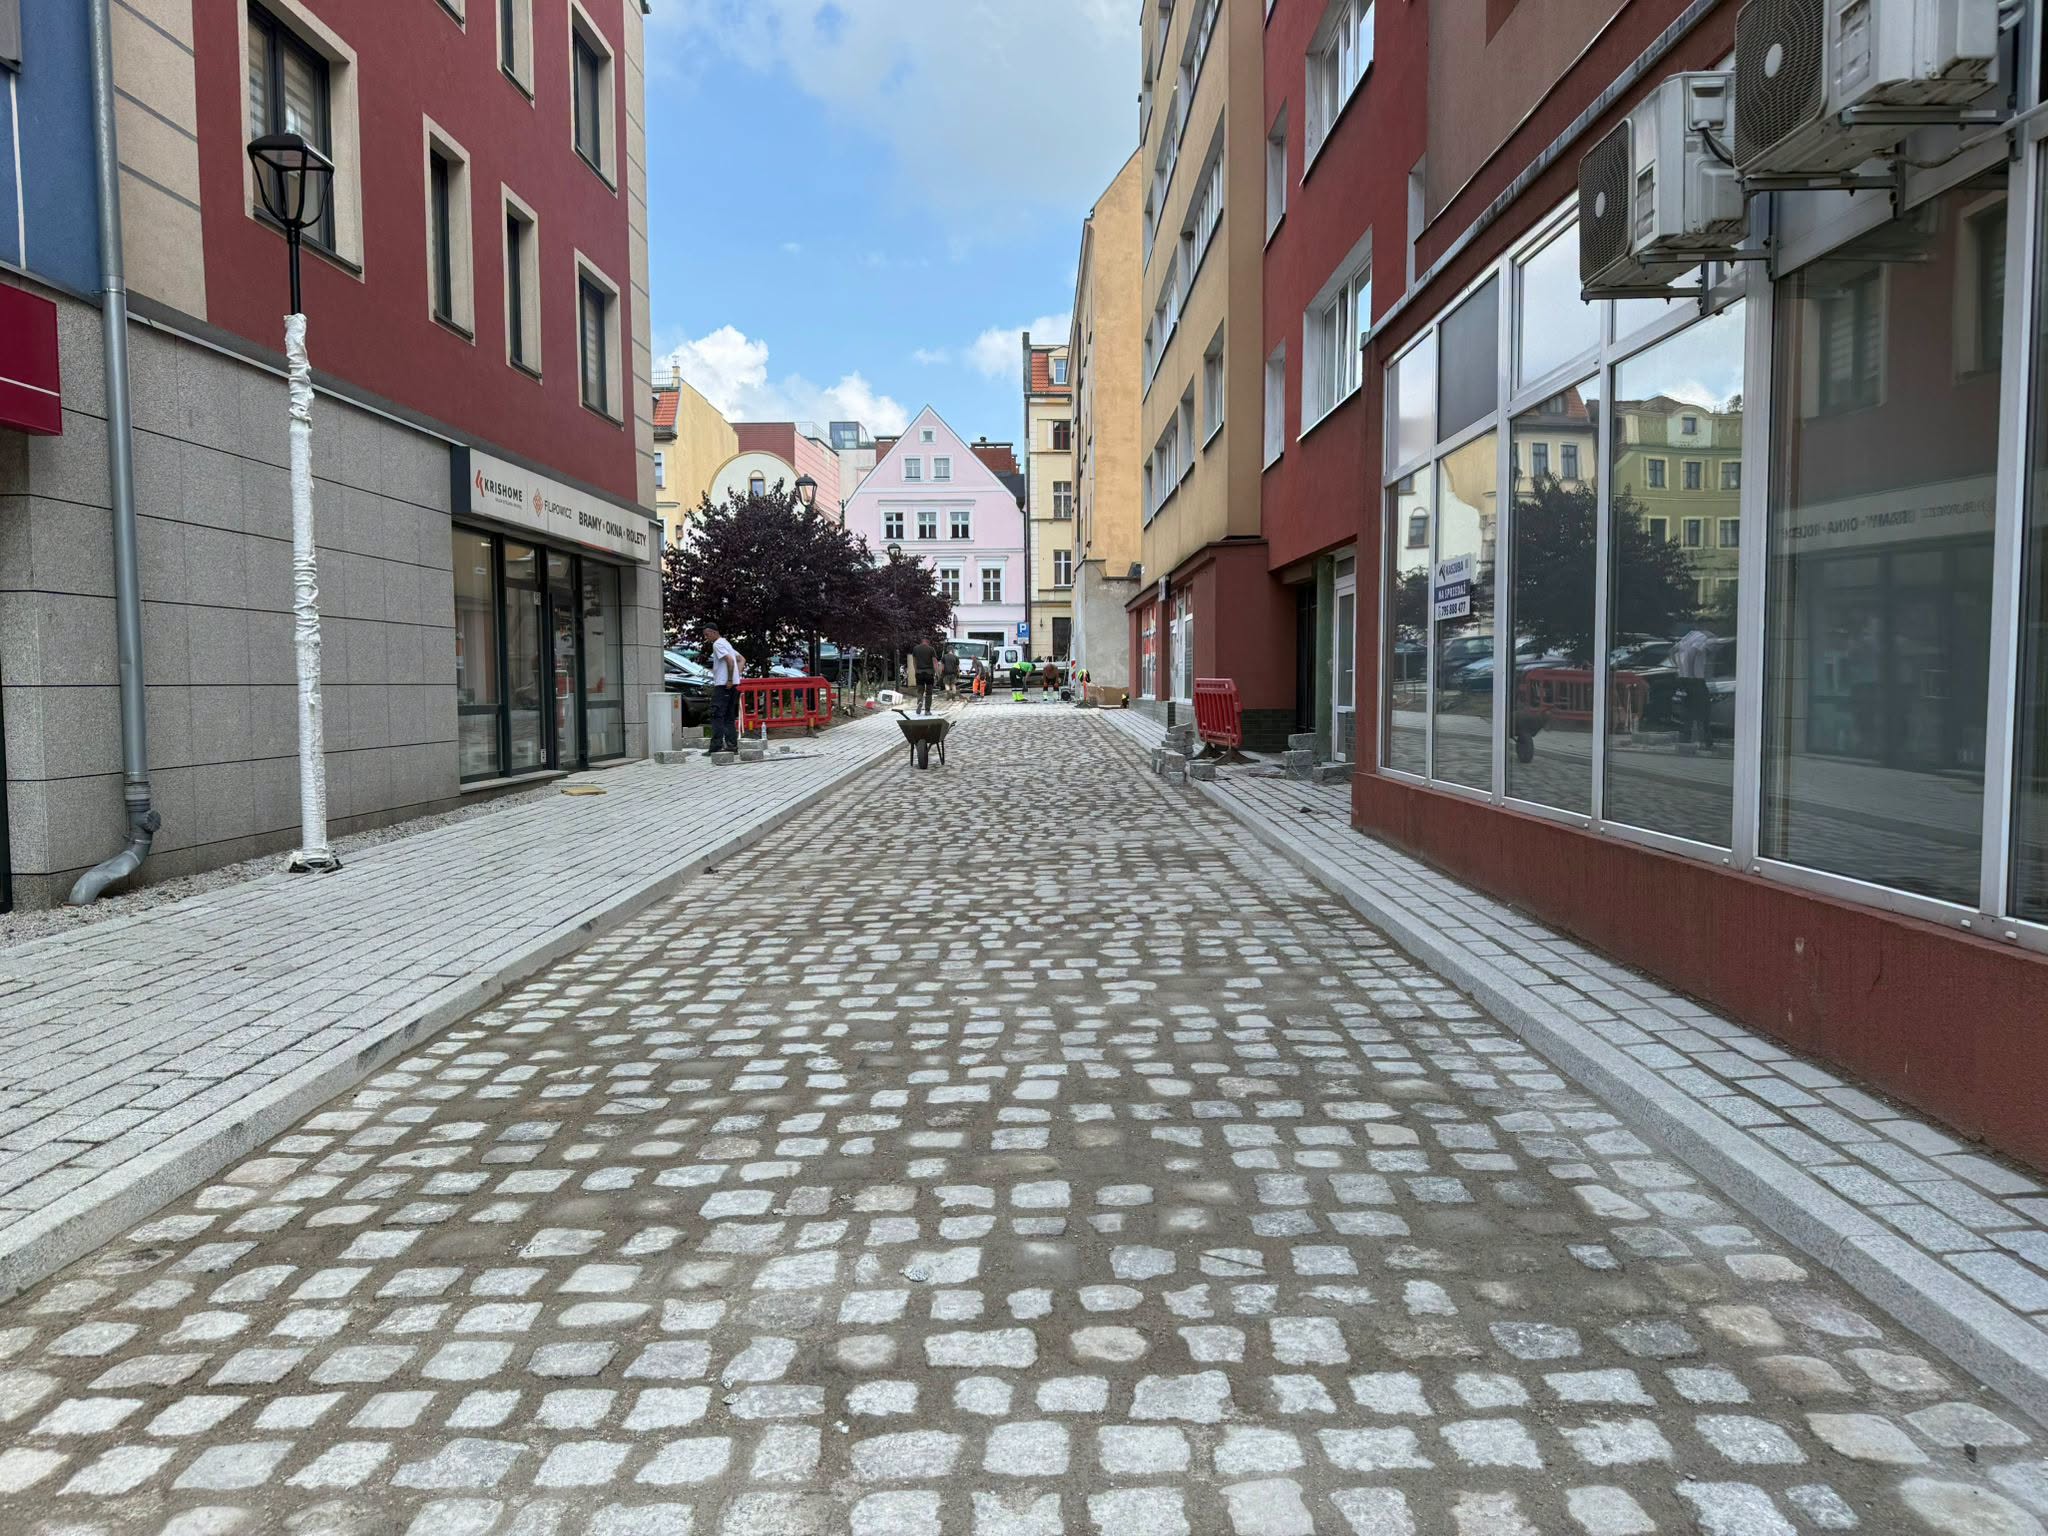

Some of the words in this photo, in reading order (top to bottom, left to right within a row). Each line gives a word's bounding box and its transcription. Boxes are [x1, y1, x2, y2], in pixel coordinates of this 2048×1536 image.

[484, 478, 523, 503] KRISHOME
[578, 511, 602, 532] BRAMY
[606, 521, 623, 539] OKNA
[626, 528, 647, 546] ROLETY
[1020, 622, 1027, 633] P
